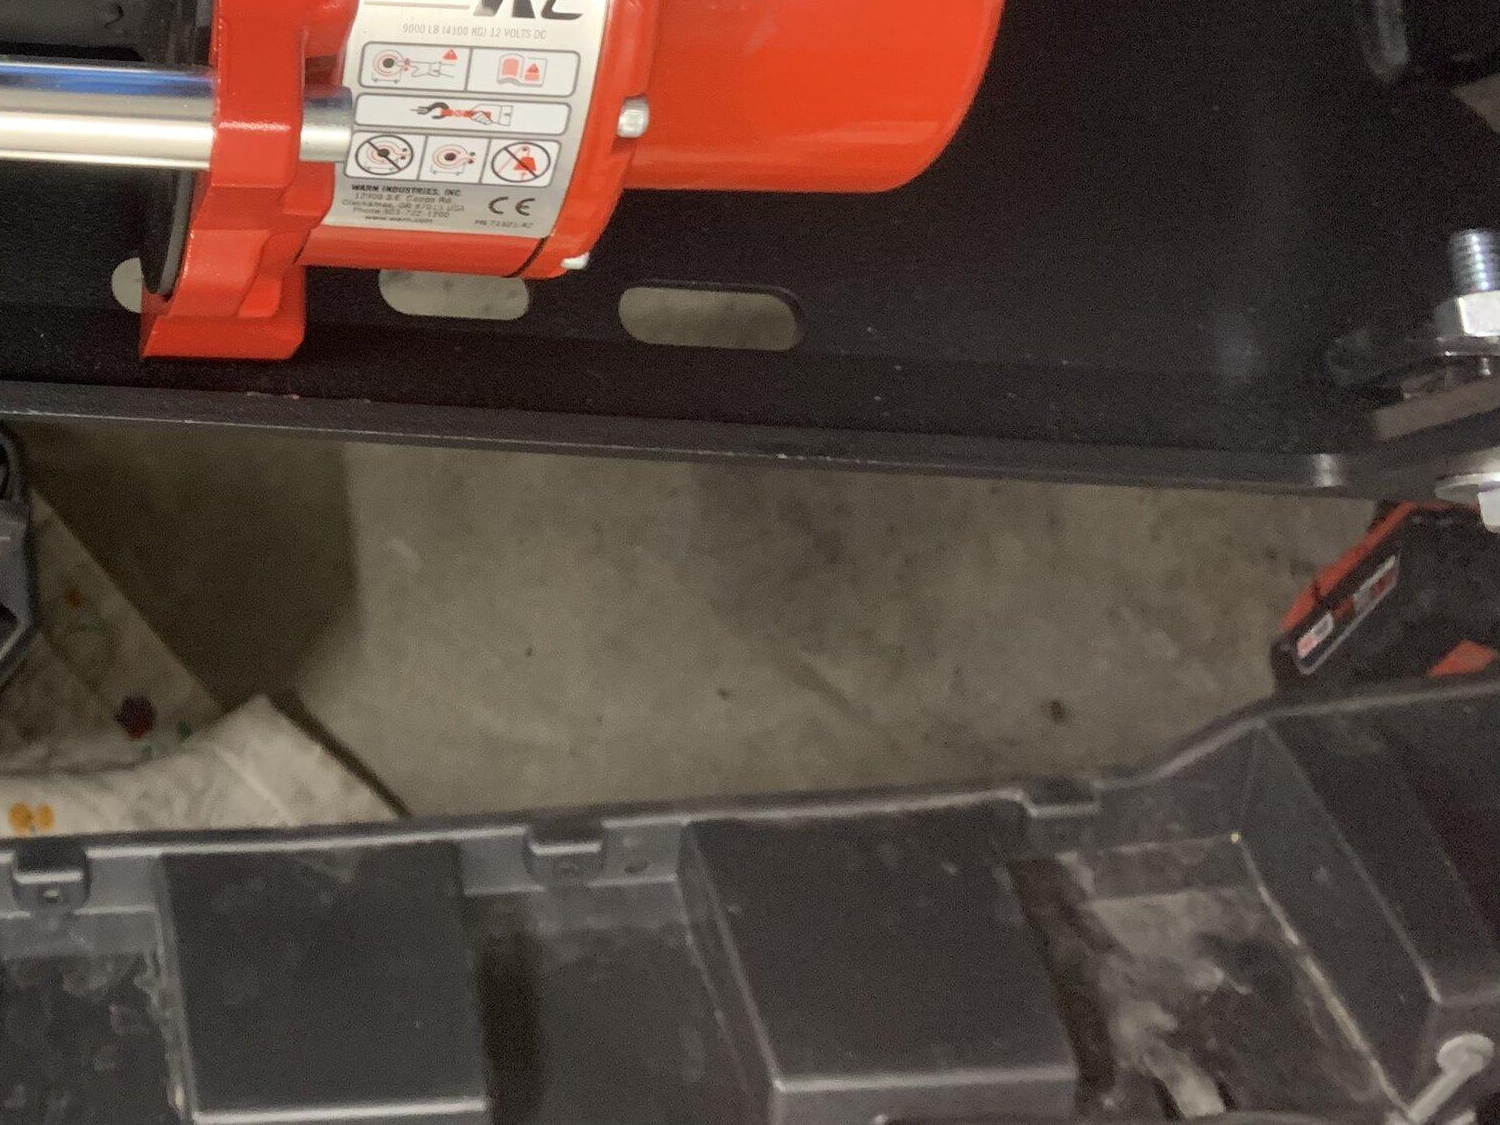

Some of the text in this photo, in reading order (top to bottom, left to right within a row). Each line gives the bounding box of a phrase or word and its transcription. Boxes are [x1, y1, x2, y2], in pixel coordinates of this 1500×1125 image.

[402, 23, 548, 40] 9000 LB (4100 KG) 12 VOLTS DC
[351, 184, 379, 192] WARN
[443, 189, 463, 197] INC.
